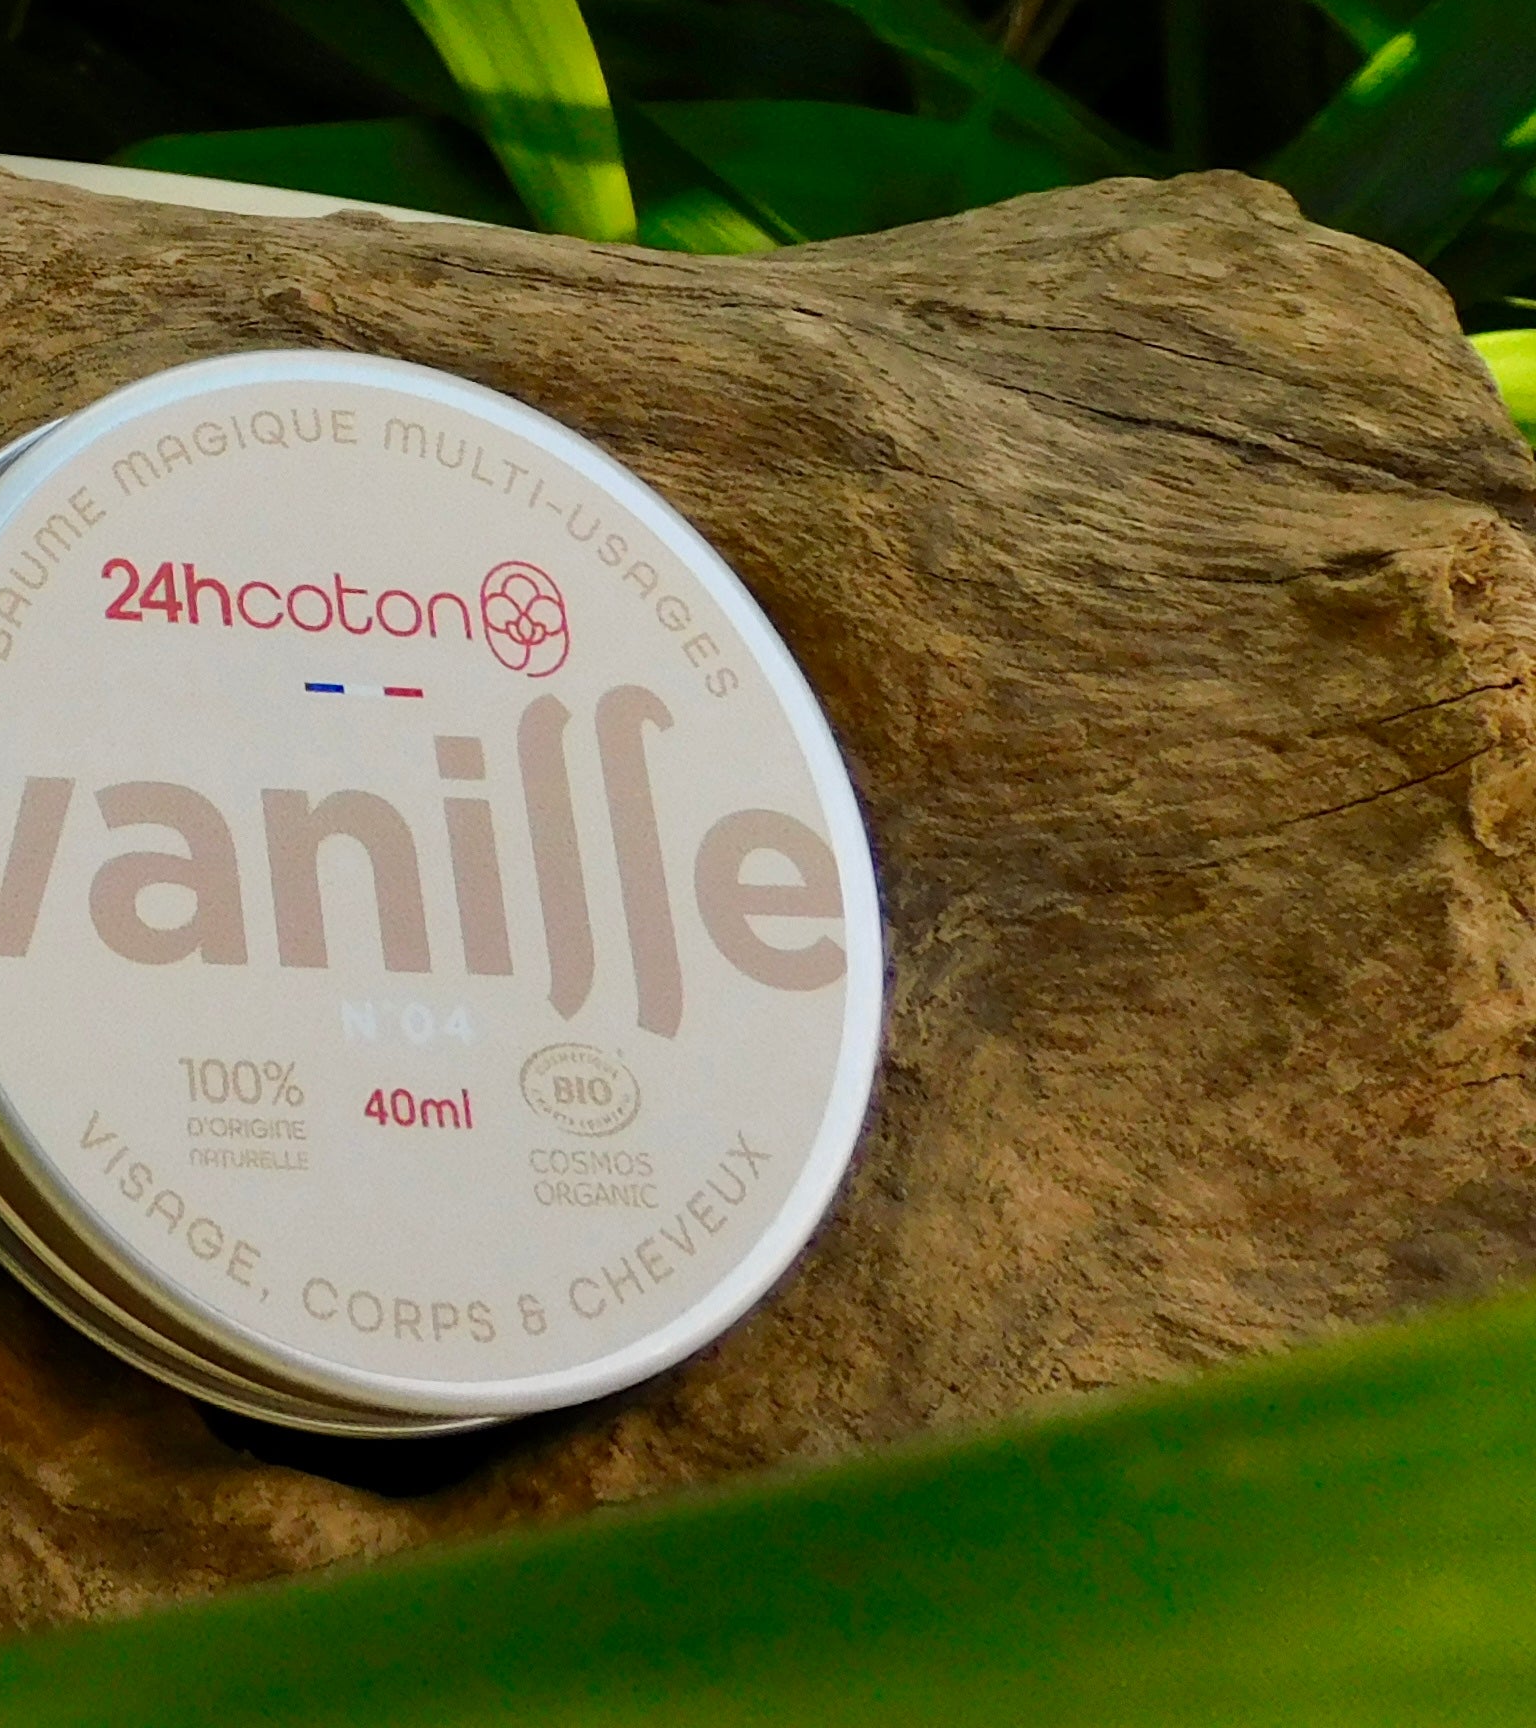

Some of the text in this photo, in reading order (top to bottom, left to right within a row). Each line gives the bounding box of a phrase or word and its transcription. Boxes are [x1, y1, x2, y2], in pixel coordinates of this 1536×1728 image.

[111, 408, 358, 495] MAGIQUE
[384, 417, 740, 698] MULTI-USAGES
[101, 558, 472, 640] 24hcoton
[178, 1058, 305, 1107] 100%
[553, 1076, 612, 1106] BIO
[364, 1088, 473, 1130] 40ml
[187, 1117, 307, 1140] D'ORIGINE
[189, 1148, 309, 1171] NATURELLE
[530, 1148, 654, 1176] COSMOS
[534, 1180, 659, 1208] ORGANIC
[79, 1110, 772, 1343] VISAGE, CORPS & CHEVEUX
